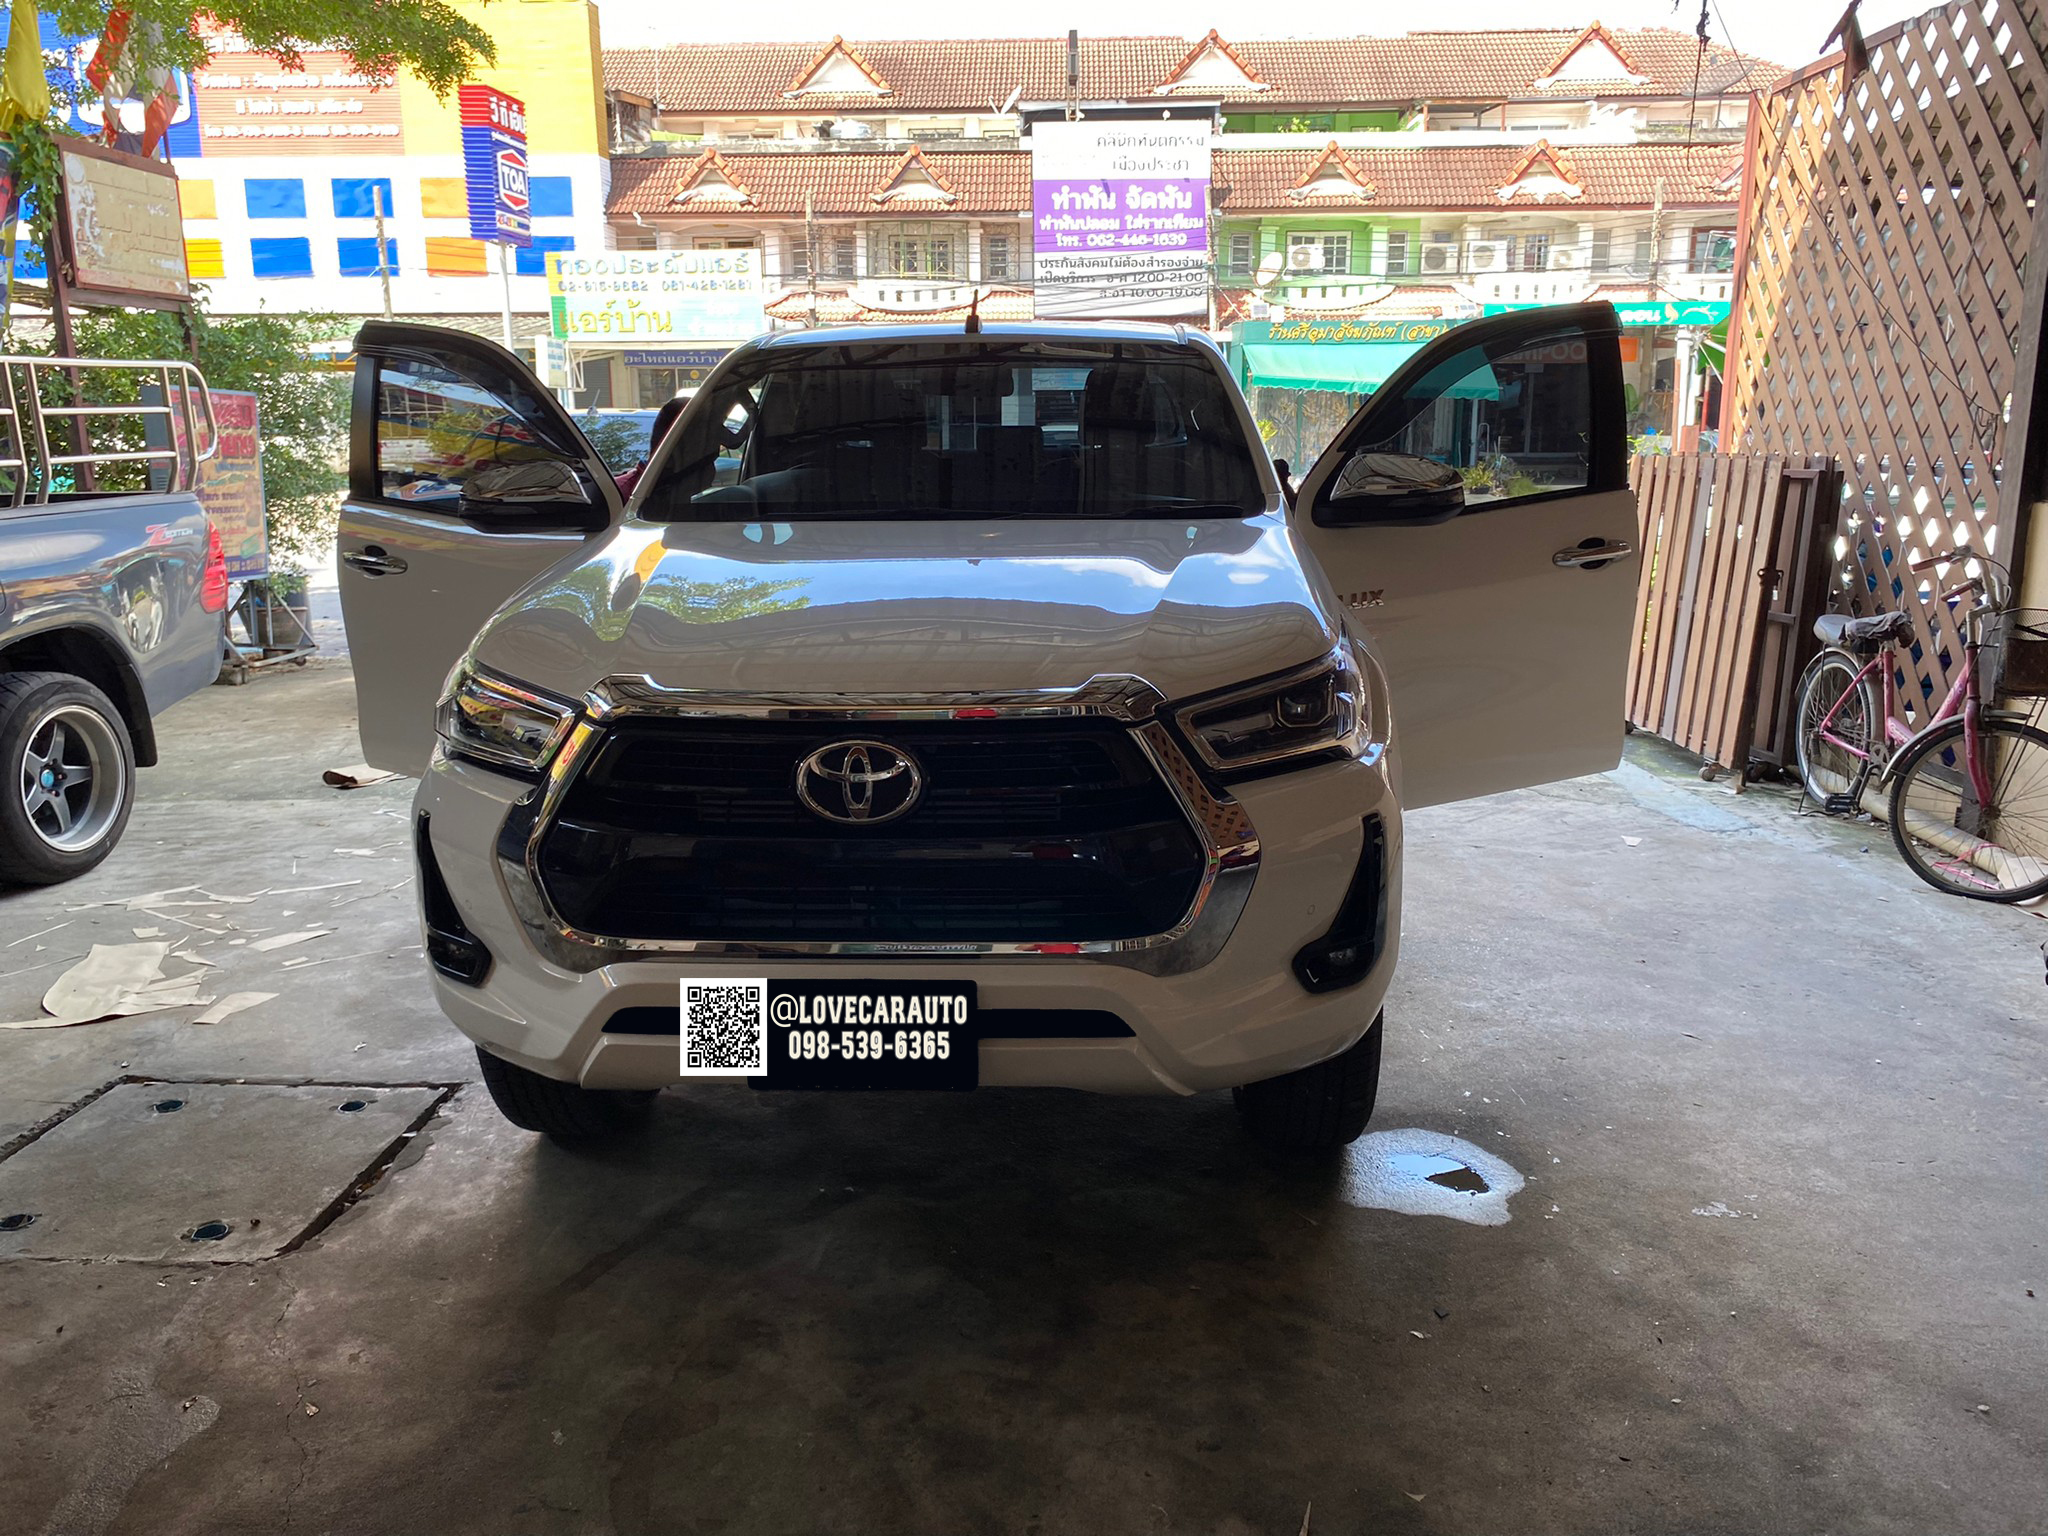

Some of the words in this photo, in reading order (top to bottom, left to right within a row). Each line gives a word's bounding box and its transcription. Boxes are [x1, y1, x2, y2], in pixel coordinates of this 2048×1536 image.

[501, 165, 526, 196] TOA
[1051, 185, 1117, 210] ทำฟัน
[1124, 184, 1193, 210] จัดฟัน
[558, 298, 673, 334] แอร์บ้าน
